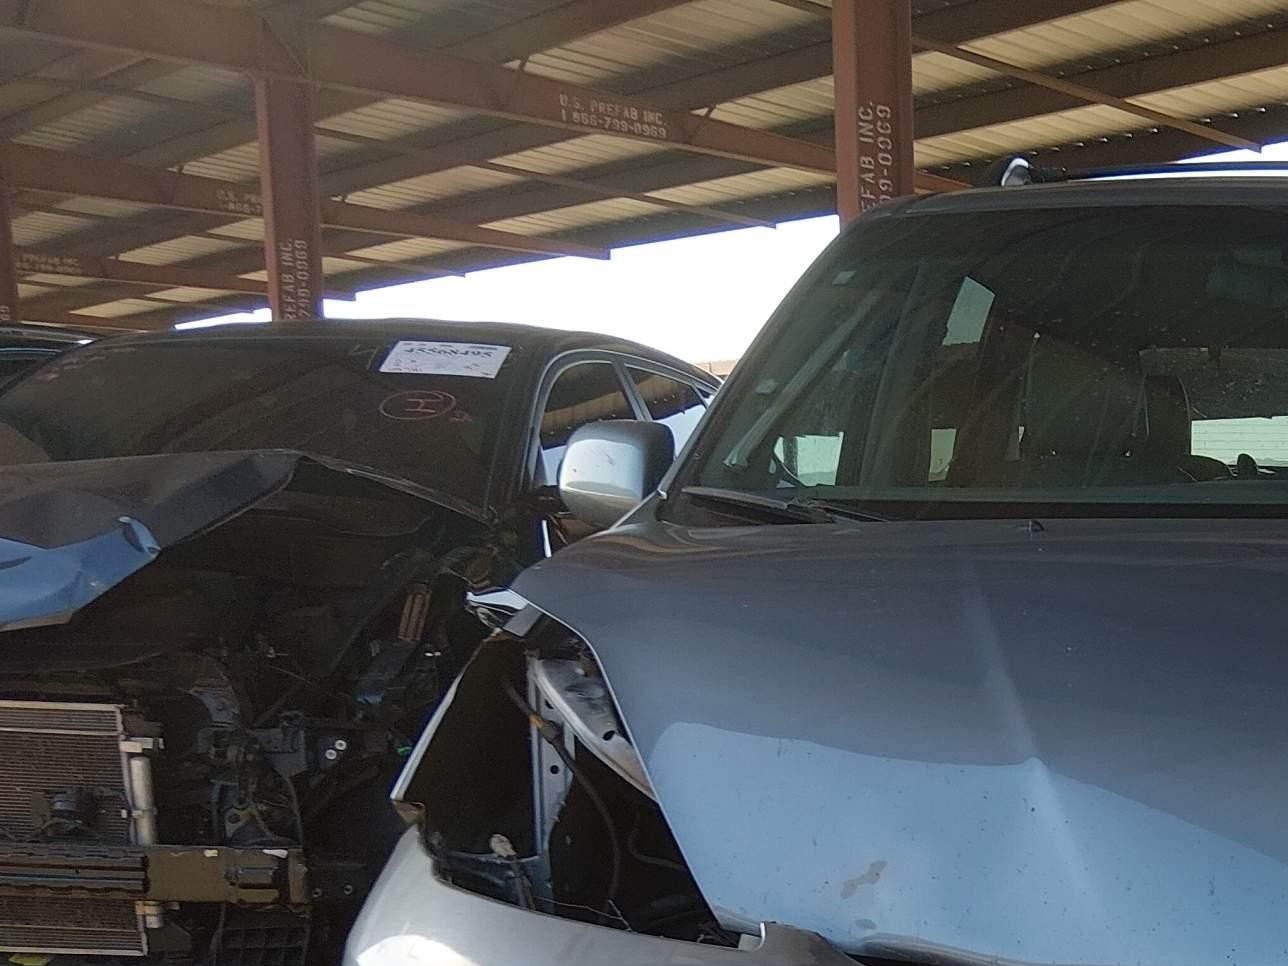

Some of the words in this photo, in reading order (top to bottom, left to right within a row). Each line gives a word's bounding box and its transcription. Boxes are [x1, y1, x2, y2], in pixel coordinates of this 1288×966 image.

[559, 93, 585, 111] U.S.
[590, 99, 639, 121] PREFAB
[642, 109, 668, 125] INC.
[857, 100, 874, 143] INC.
[280, 239, 295, 266] INC.
